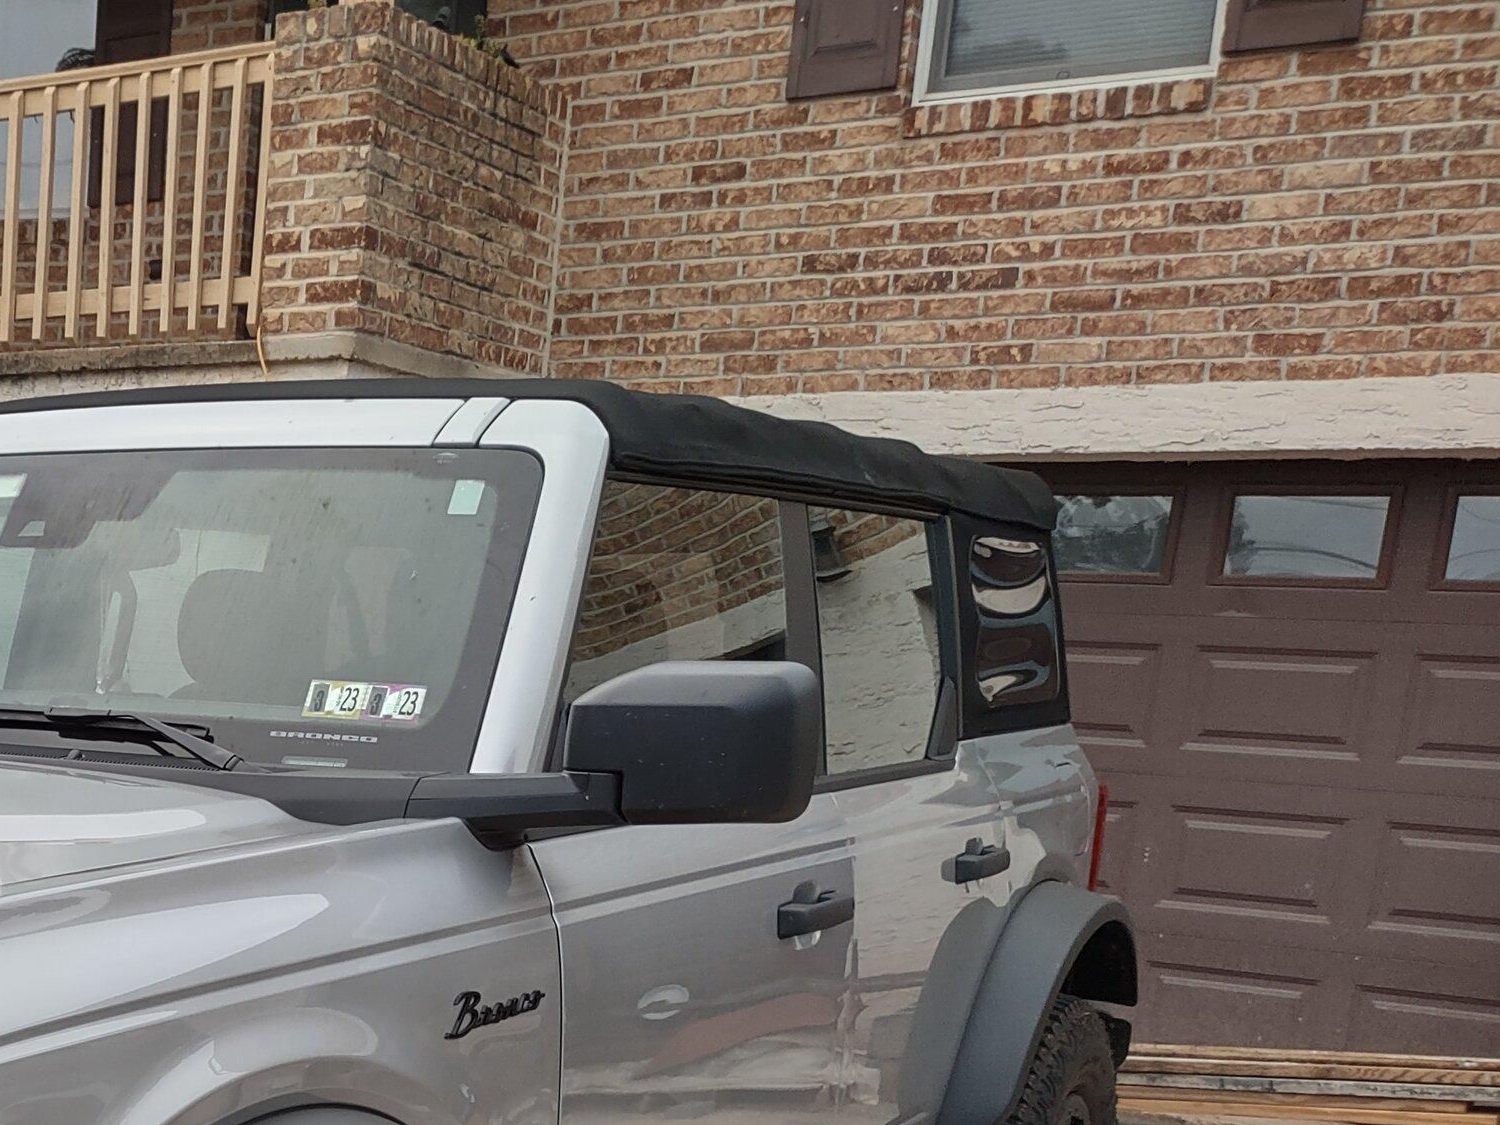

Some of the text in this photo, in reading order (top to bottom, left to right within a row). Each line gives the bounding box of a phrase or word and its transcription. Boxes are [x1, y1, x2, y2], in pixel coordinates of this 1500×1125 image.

[313, 690, 325, 712] 3
[339, 686, 360, 712] 23
[370, 692, 382, 716] 3
[398, 690, 419, 716] 23
[270, 730, 378, 743] BRONCO
[444, 989, 546, 1040] Bronco
